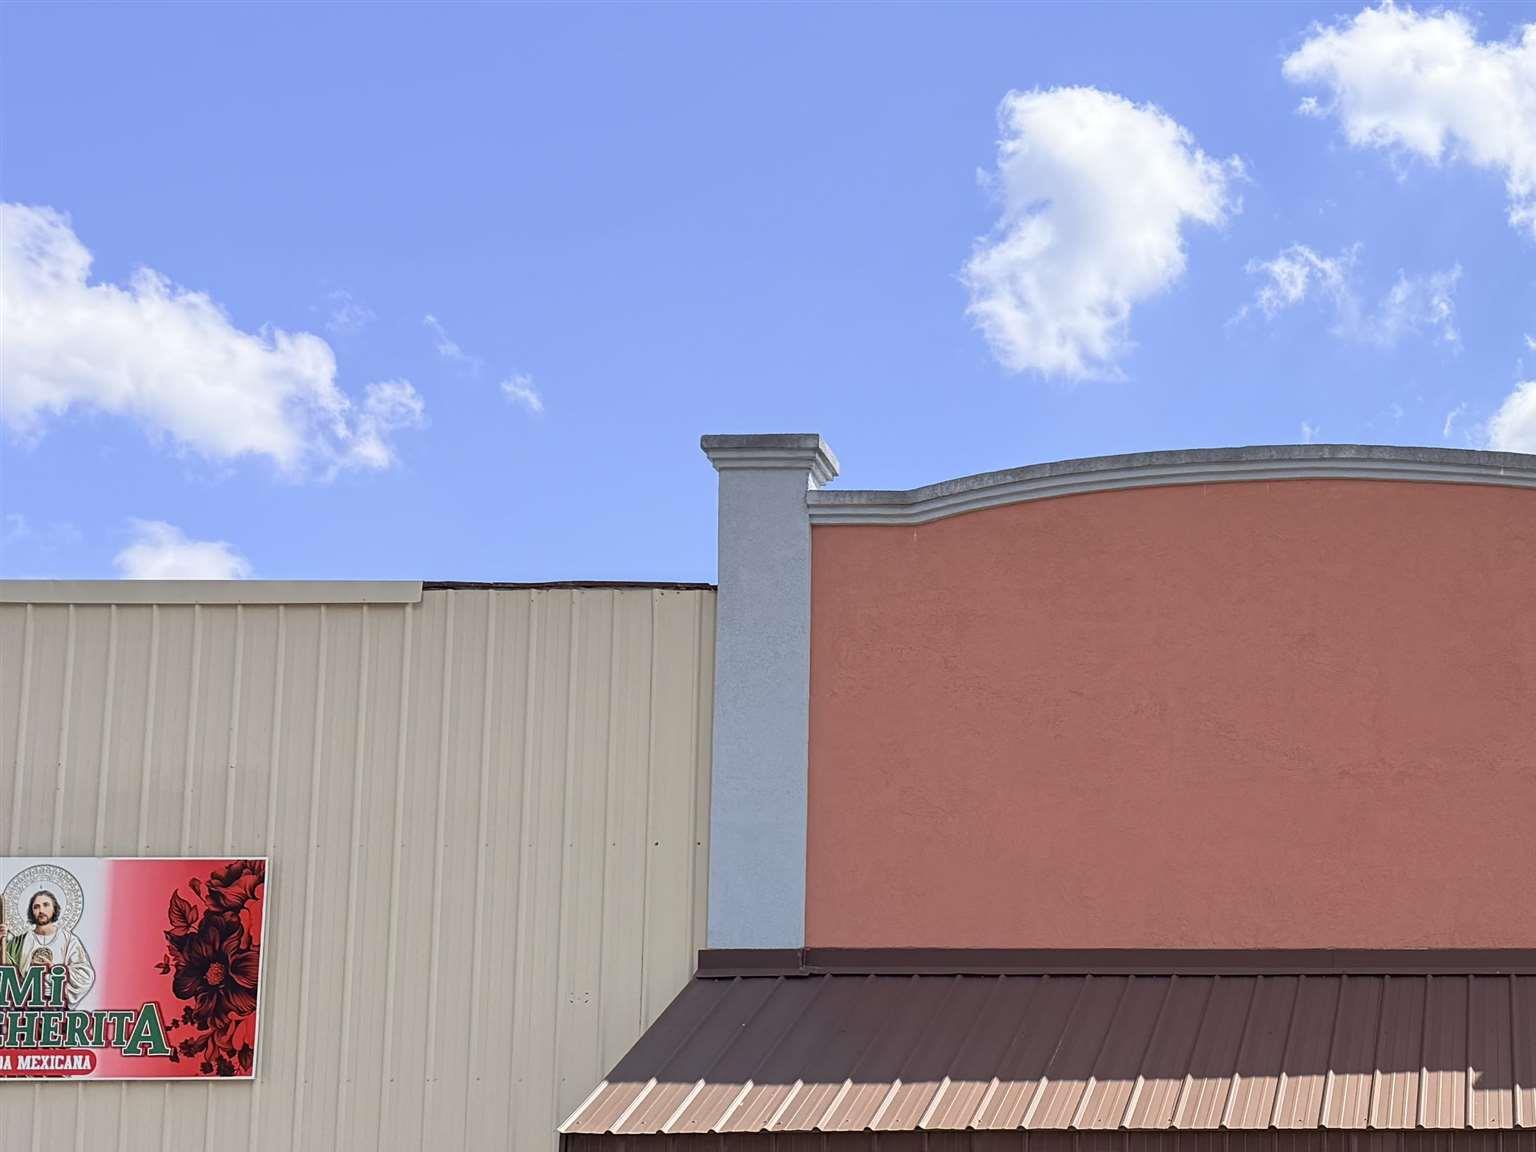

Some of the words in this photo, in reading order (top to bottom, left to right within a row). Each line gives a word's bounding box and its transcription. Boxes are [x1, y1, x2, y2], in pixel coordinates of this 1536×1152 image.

[0, 965, 67, 1007] Mi
[0, 1002, 171, 1057] HERITA
[17, 1055, 92, 1070] MEXICANA
